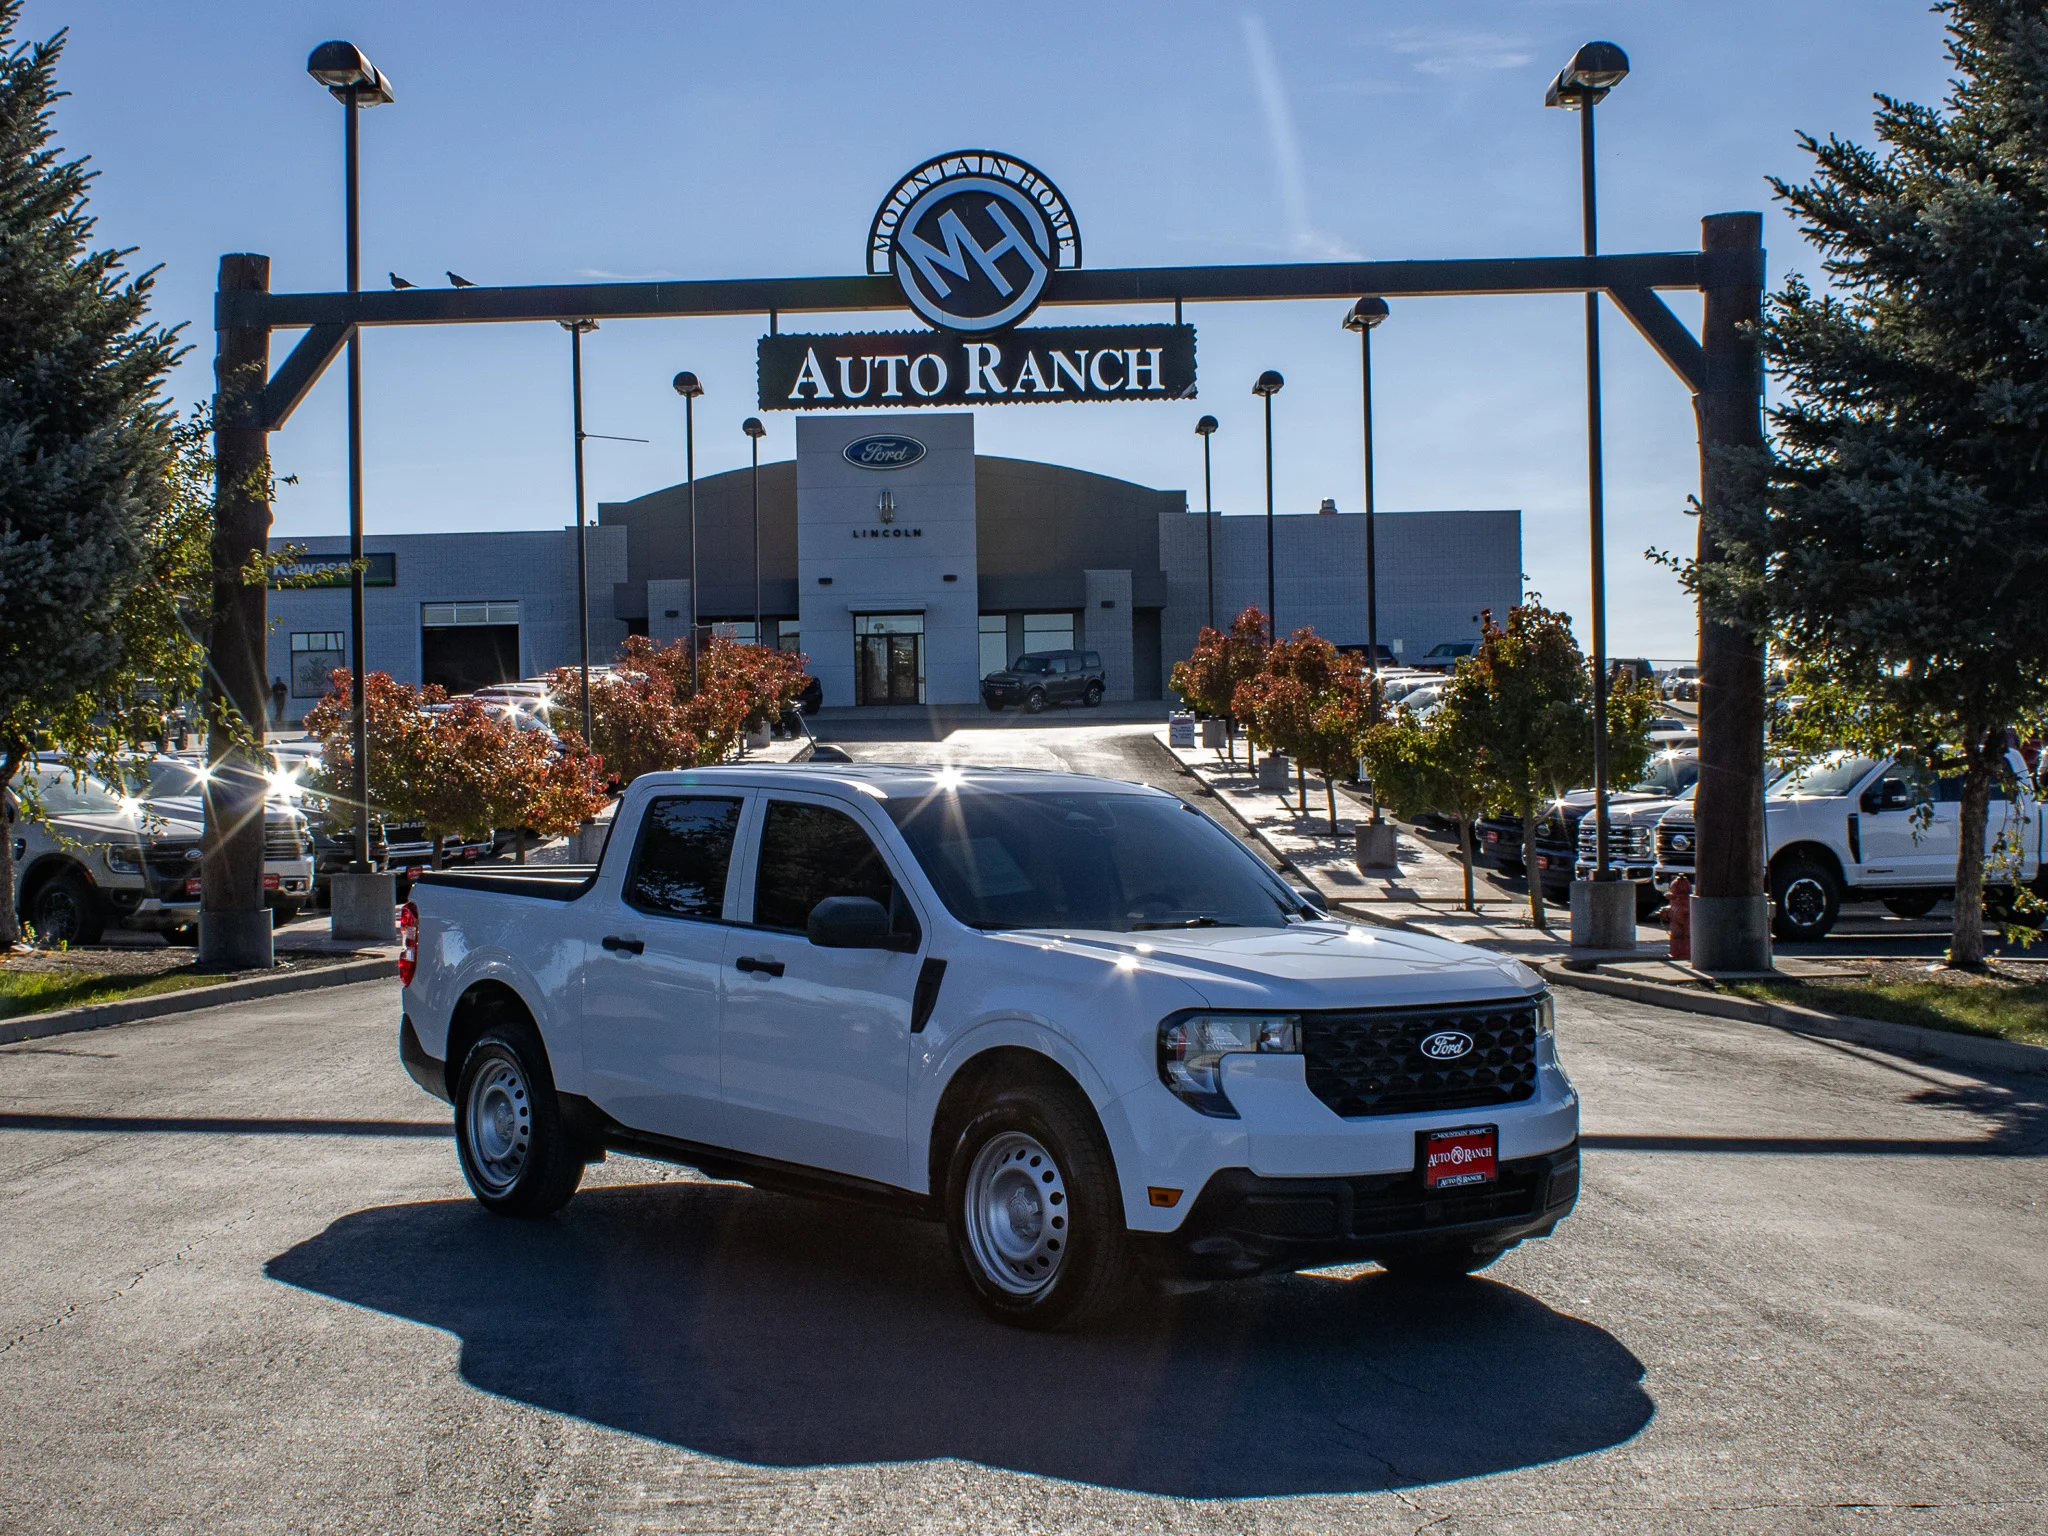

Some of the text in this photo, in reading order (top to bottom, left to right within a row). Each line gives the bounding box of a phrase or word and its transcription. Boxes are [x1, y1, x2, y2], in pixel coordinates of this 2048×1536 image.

[873, 155, 1075, 253] MOUNTAIN HOME
[788, 343, 1166, 400] AUTO RANCH
[860, 441, 908, 463] Ford
[853, 528, 922, 539] LINCOLN
[1431, 1035, 1464, 1055] Ford
[1427, 1152, 1451, 1168] AUTO
[1464, 1147, 1492, 1162] RANCH
